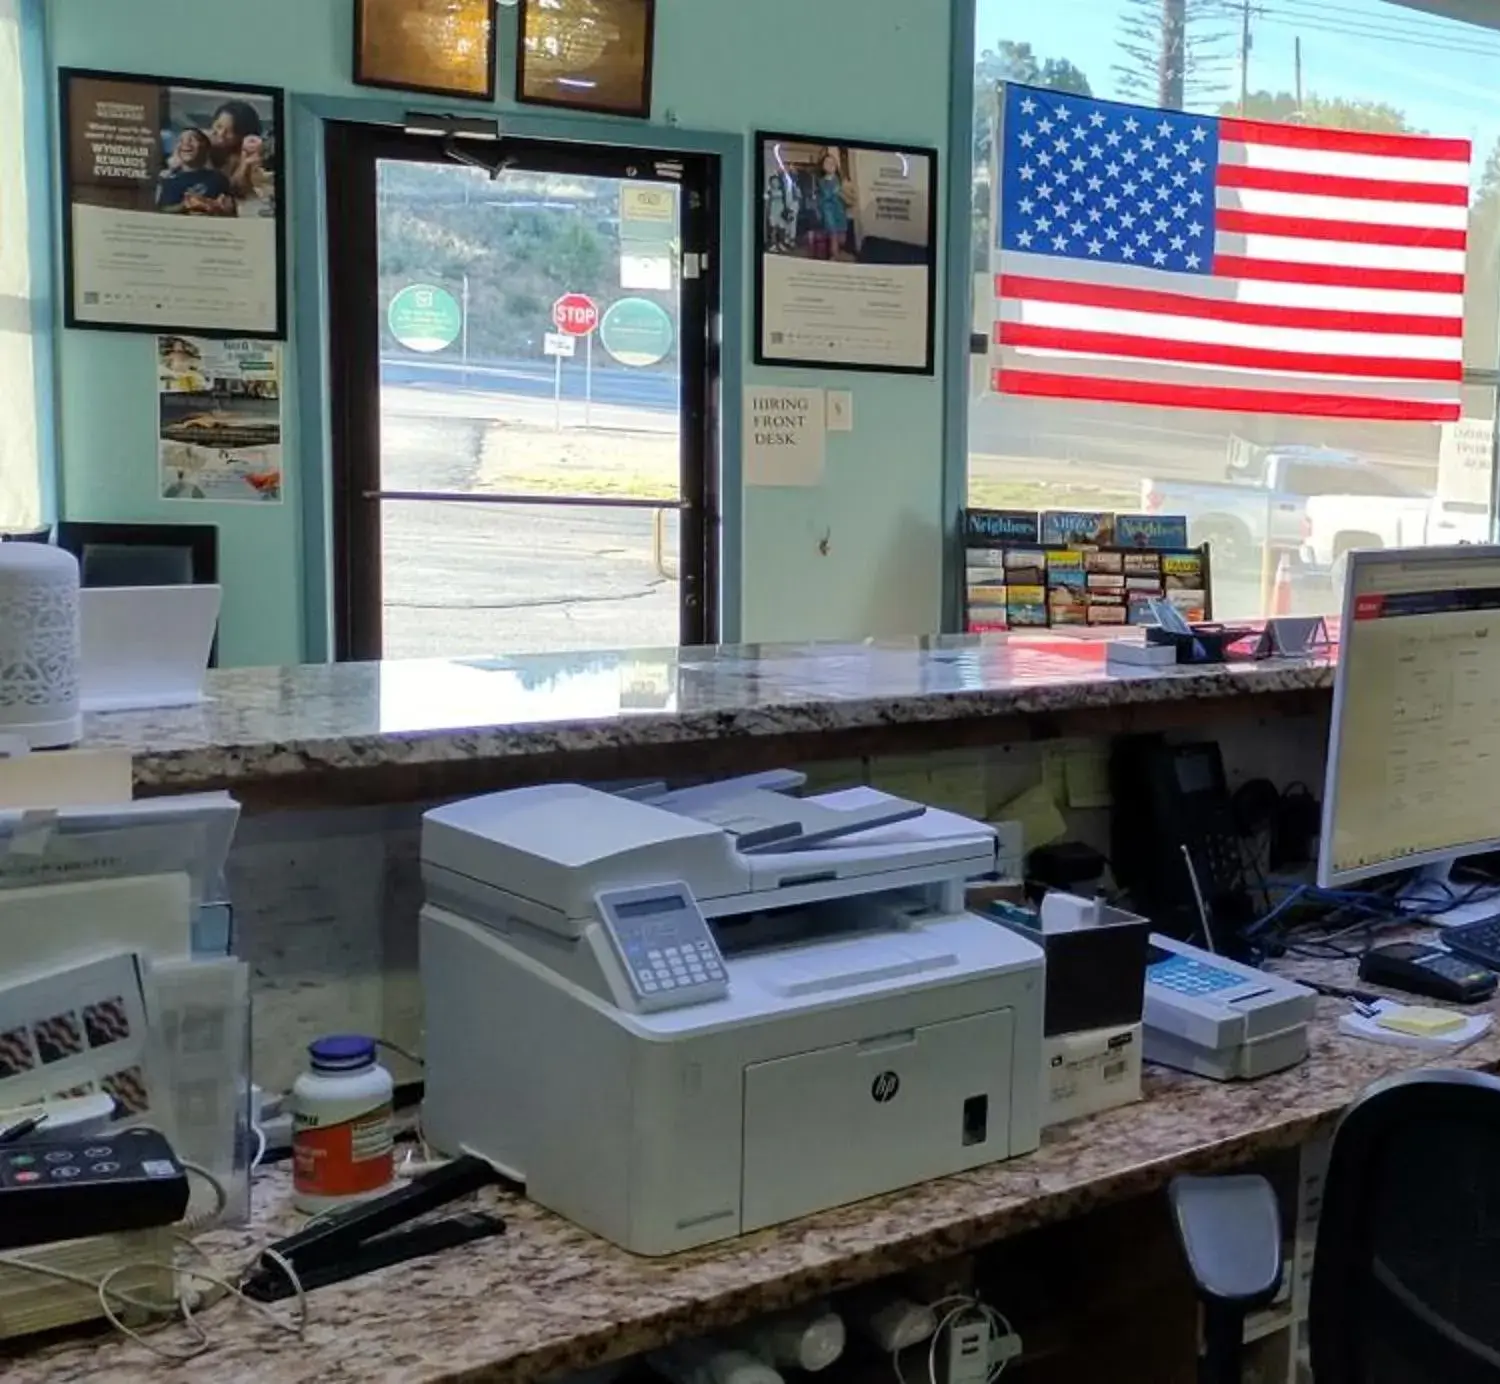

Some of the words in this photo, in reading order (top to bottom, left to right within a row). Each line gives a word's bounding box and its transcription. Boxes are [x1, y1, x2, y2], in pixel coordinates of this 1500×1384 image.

[557, 306, 596, 325] STOP
[752, 396, 809, 412] HIRING
[753, 413, 807, 429] FRONT
[754, 431, 798, 446] DESK
[968, 514, 1035, 535] Neighbors
